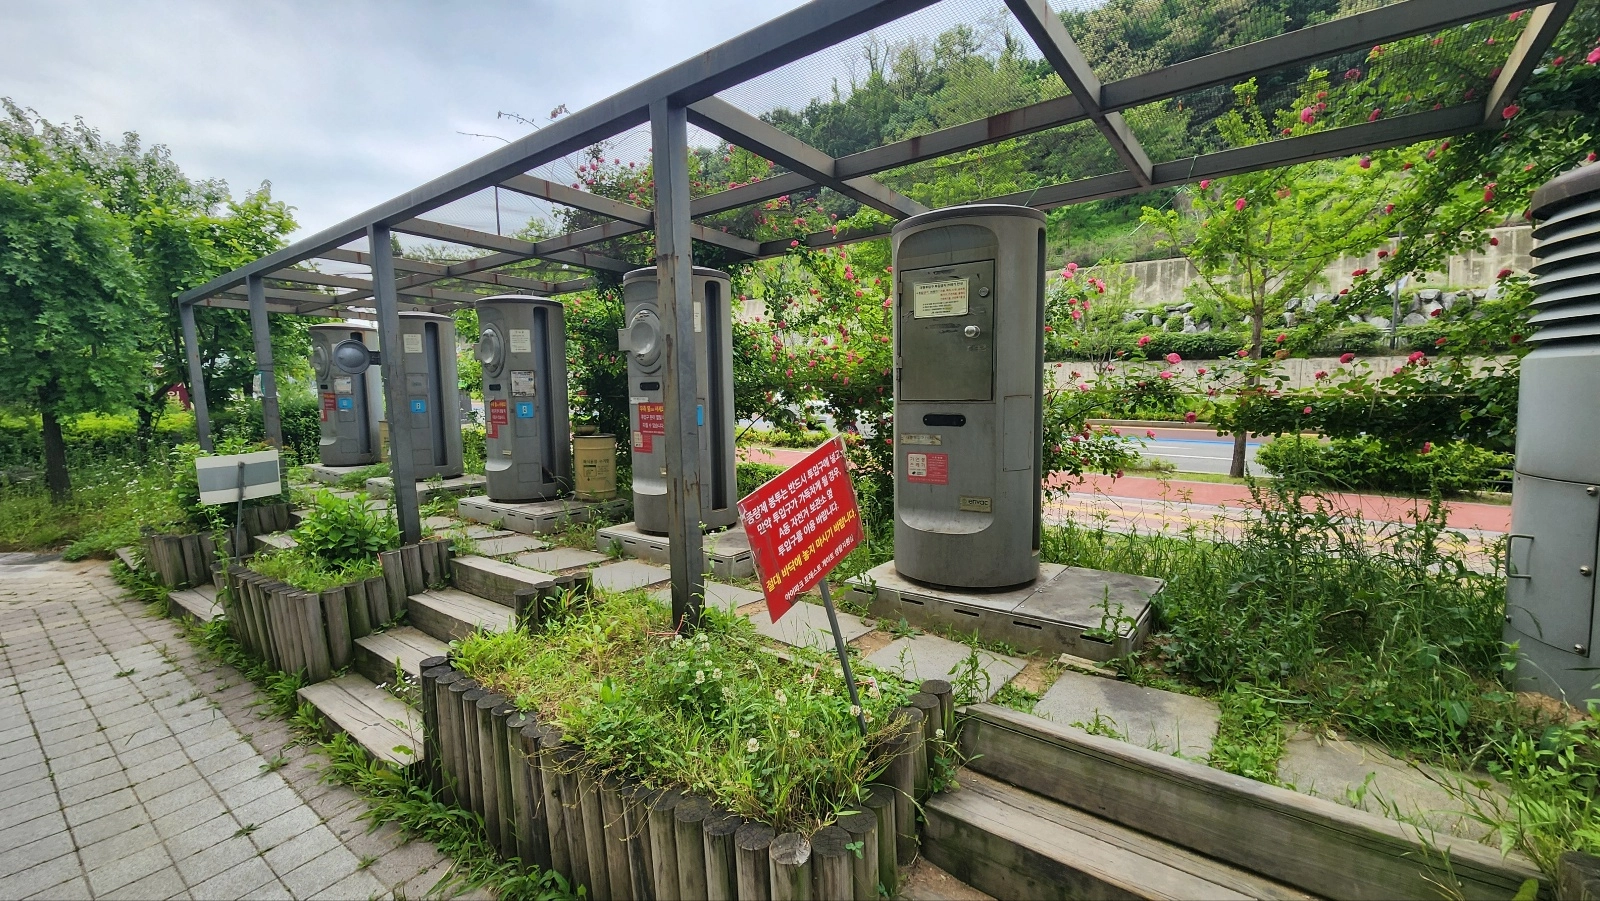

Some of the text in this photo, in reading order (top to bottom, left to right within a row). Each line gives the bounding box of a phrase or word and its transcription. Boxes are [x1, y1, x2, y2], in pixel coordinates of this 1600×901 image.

[746, 500, 768, 525] 종량제
[768, 489, 788, 509] 봉투는
[787, 473, 808, 495] 반드시
[807, 456, 831, 480] 투입구에
[756, 516, 773, 535] 만약
[772, 498, 799, 524] 투입구가
[798, 479, 823, 504] 가득차게
[828, 466, 842, 482] 경우,
[778, 487, 834, 539] A동 자전거 보관소 옆
[766, 508, 857, 593] 절대 바닥에 놓지 마시기 바랍니다.
[777, 500, 840, 557] 투입구를 이용 바랍니다.
[784, 580, 805, 601] 아이파크
